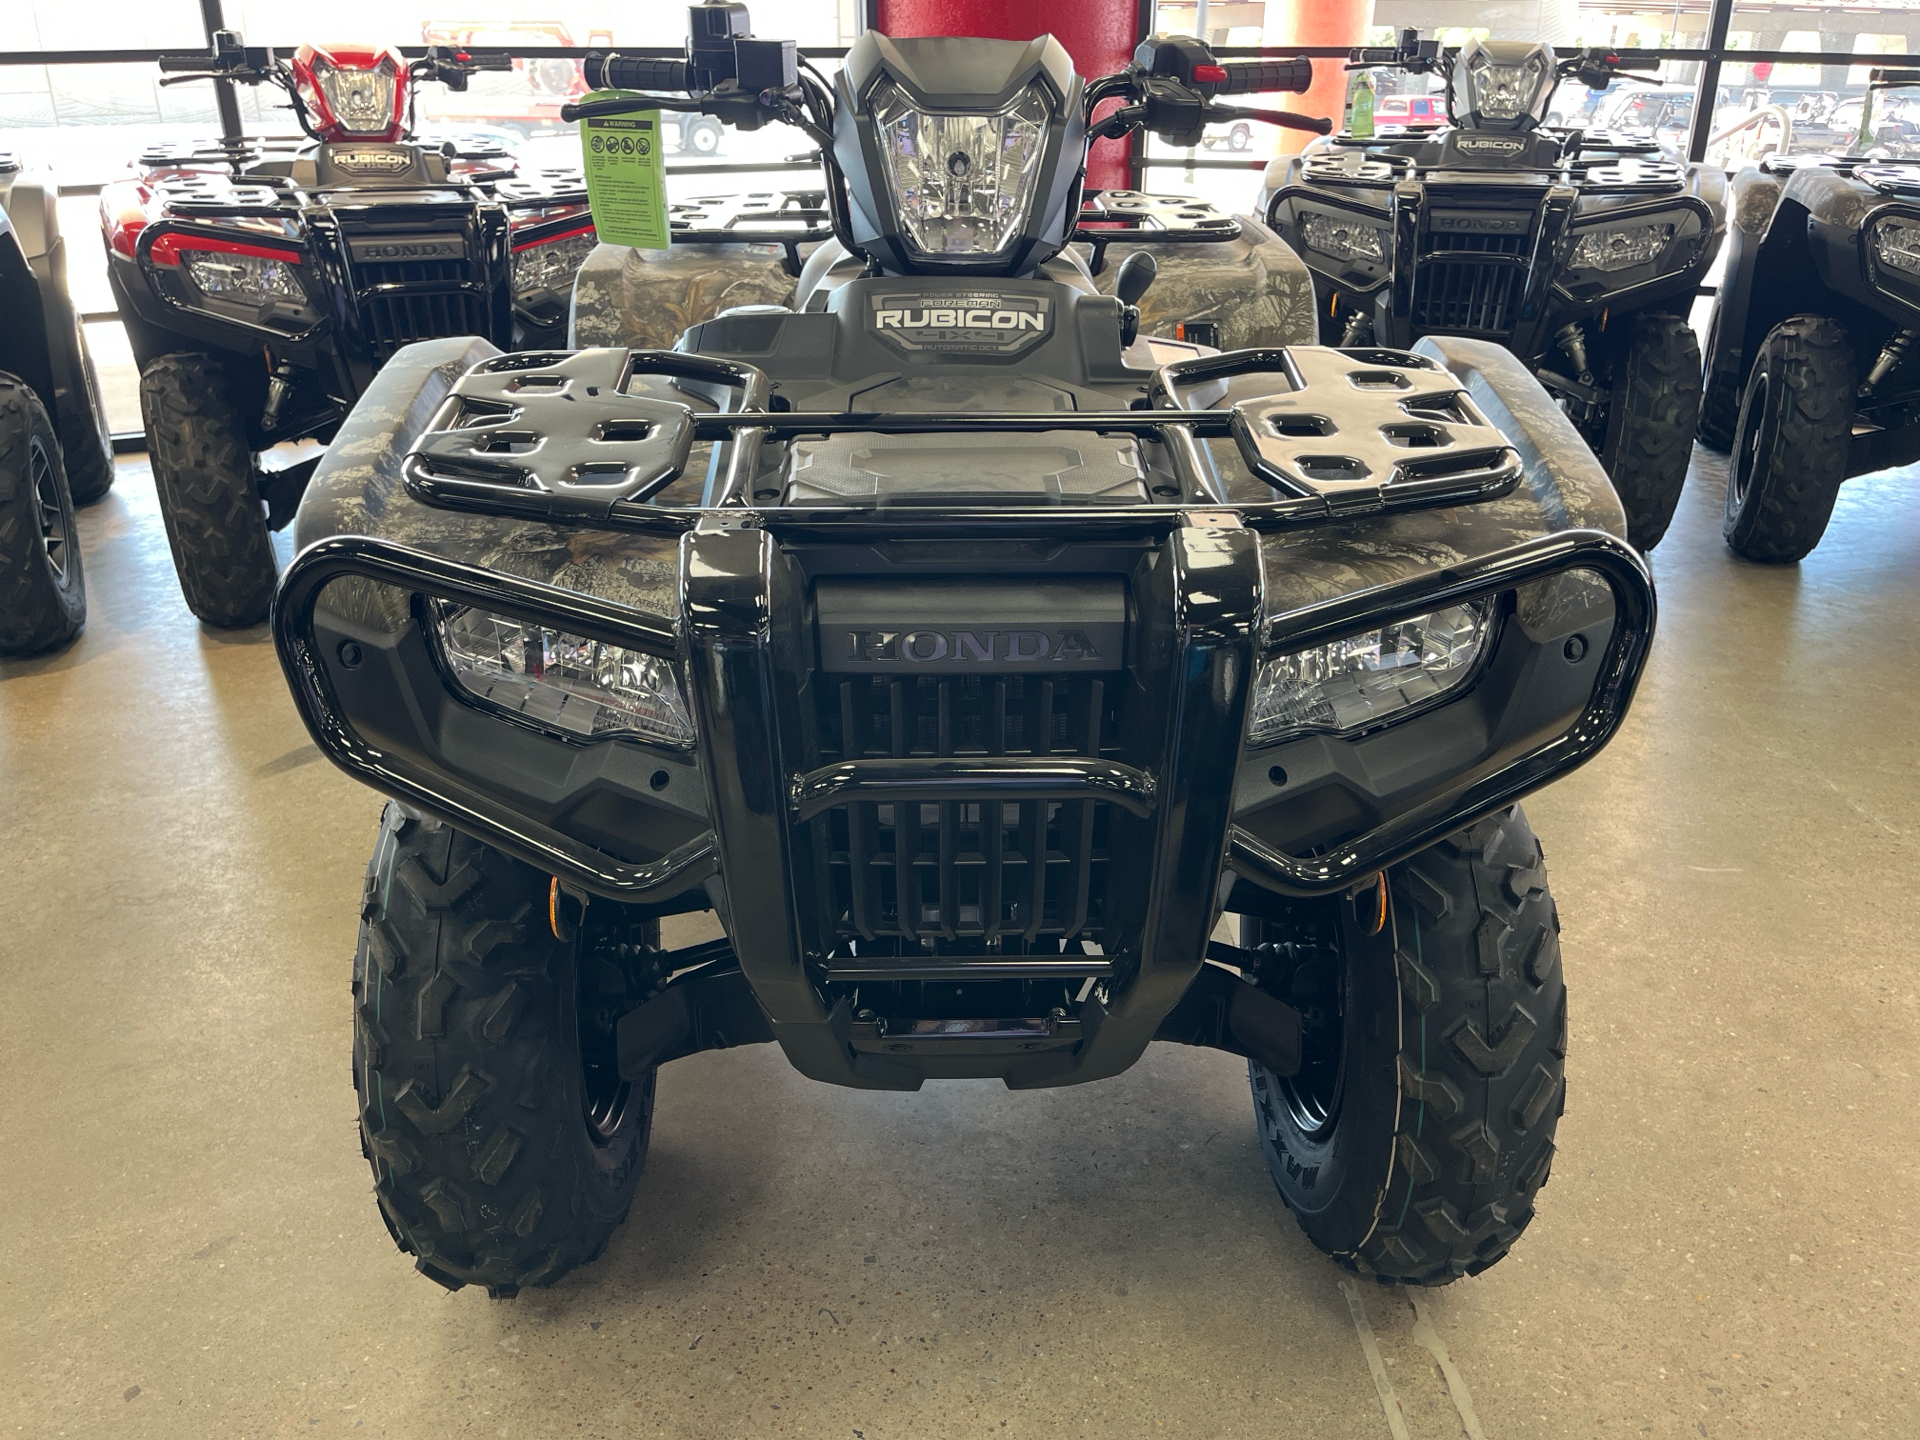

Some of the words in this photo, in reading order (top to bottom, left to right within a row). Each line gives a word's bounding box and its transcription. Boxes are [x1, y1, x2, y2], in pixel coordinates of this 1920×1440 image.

[608, 120, 636, 128] WARNING
[1456, 140, 1525, 151] RUBICON
[333, 154, 411, 165] RUBICON
[1439, 218, 1522, 231] HONDA
[361, 244, 458, 259] HONDA
[920, 299, 1002, 309] FOREMAN
[876, 309, 1044, 330] RUBICON
[979, 344, 998, 352] DCT
[847, 629, 1104, 663] HONDA
